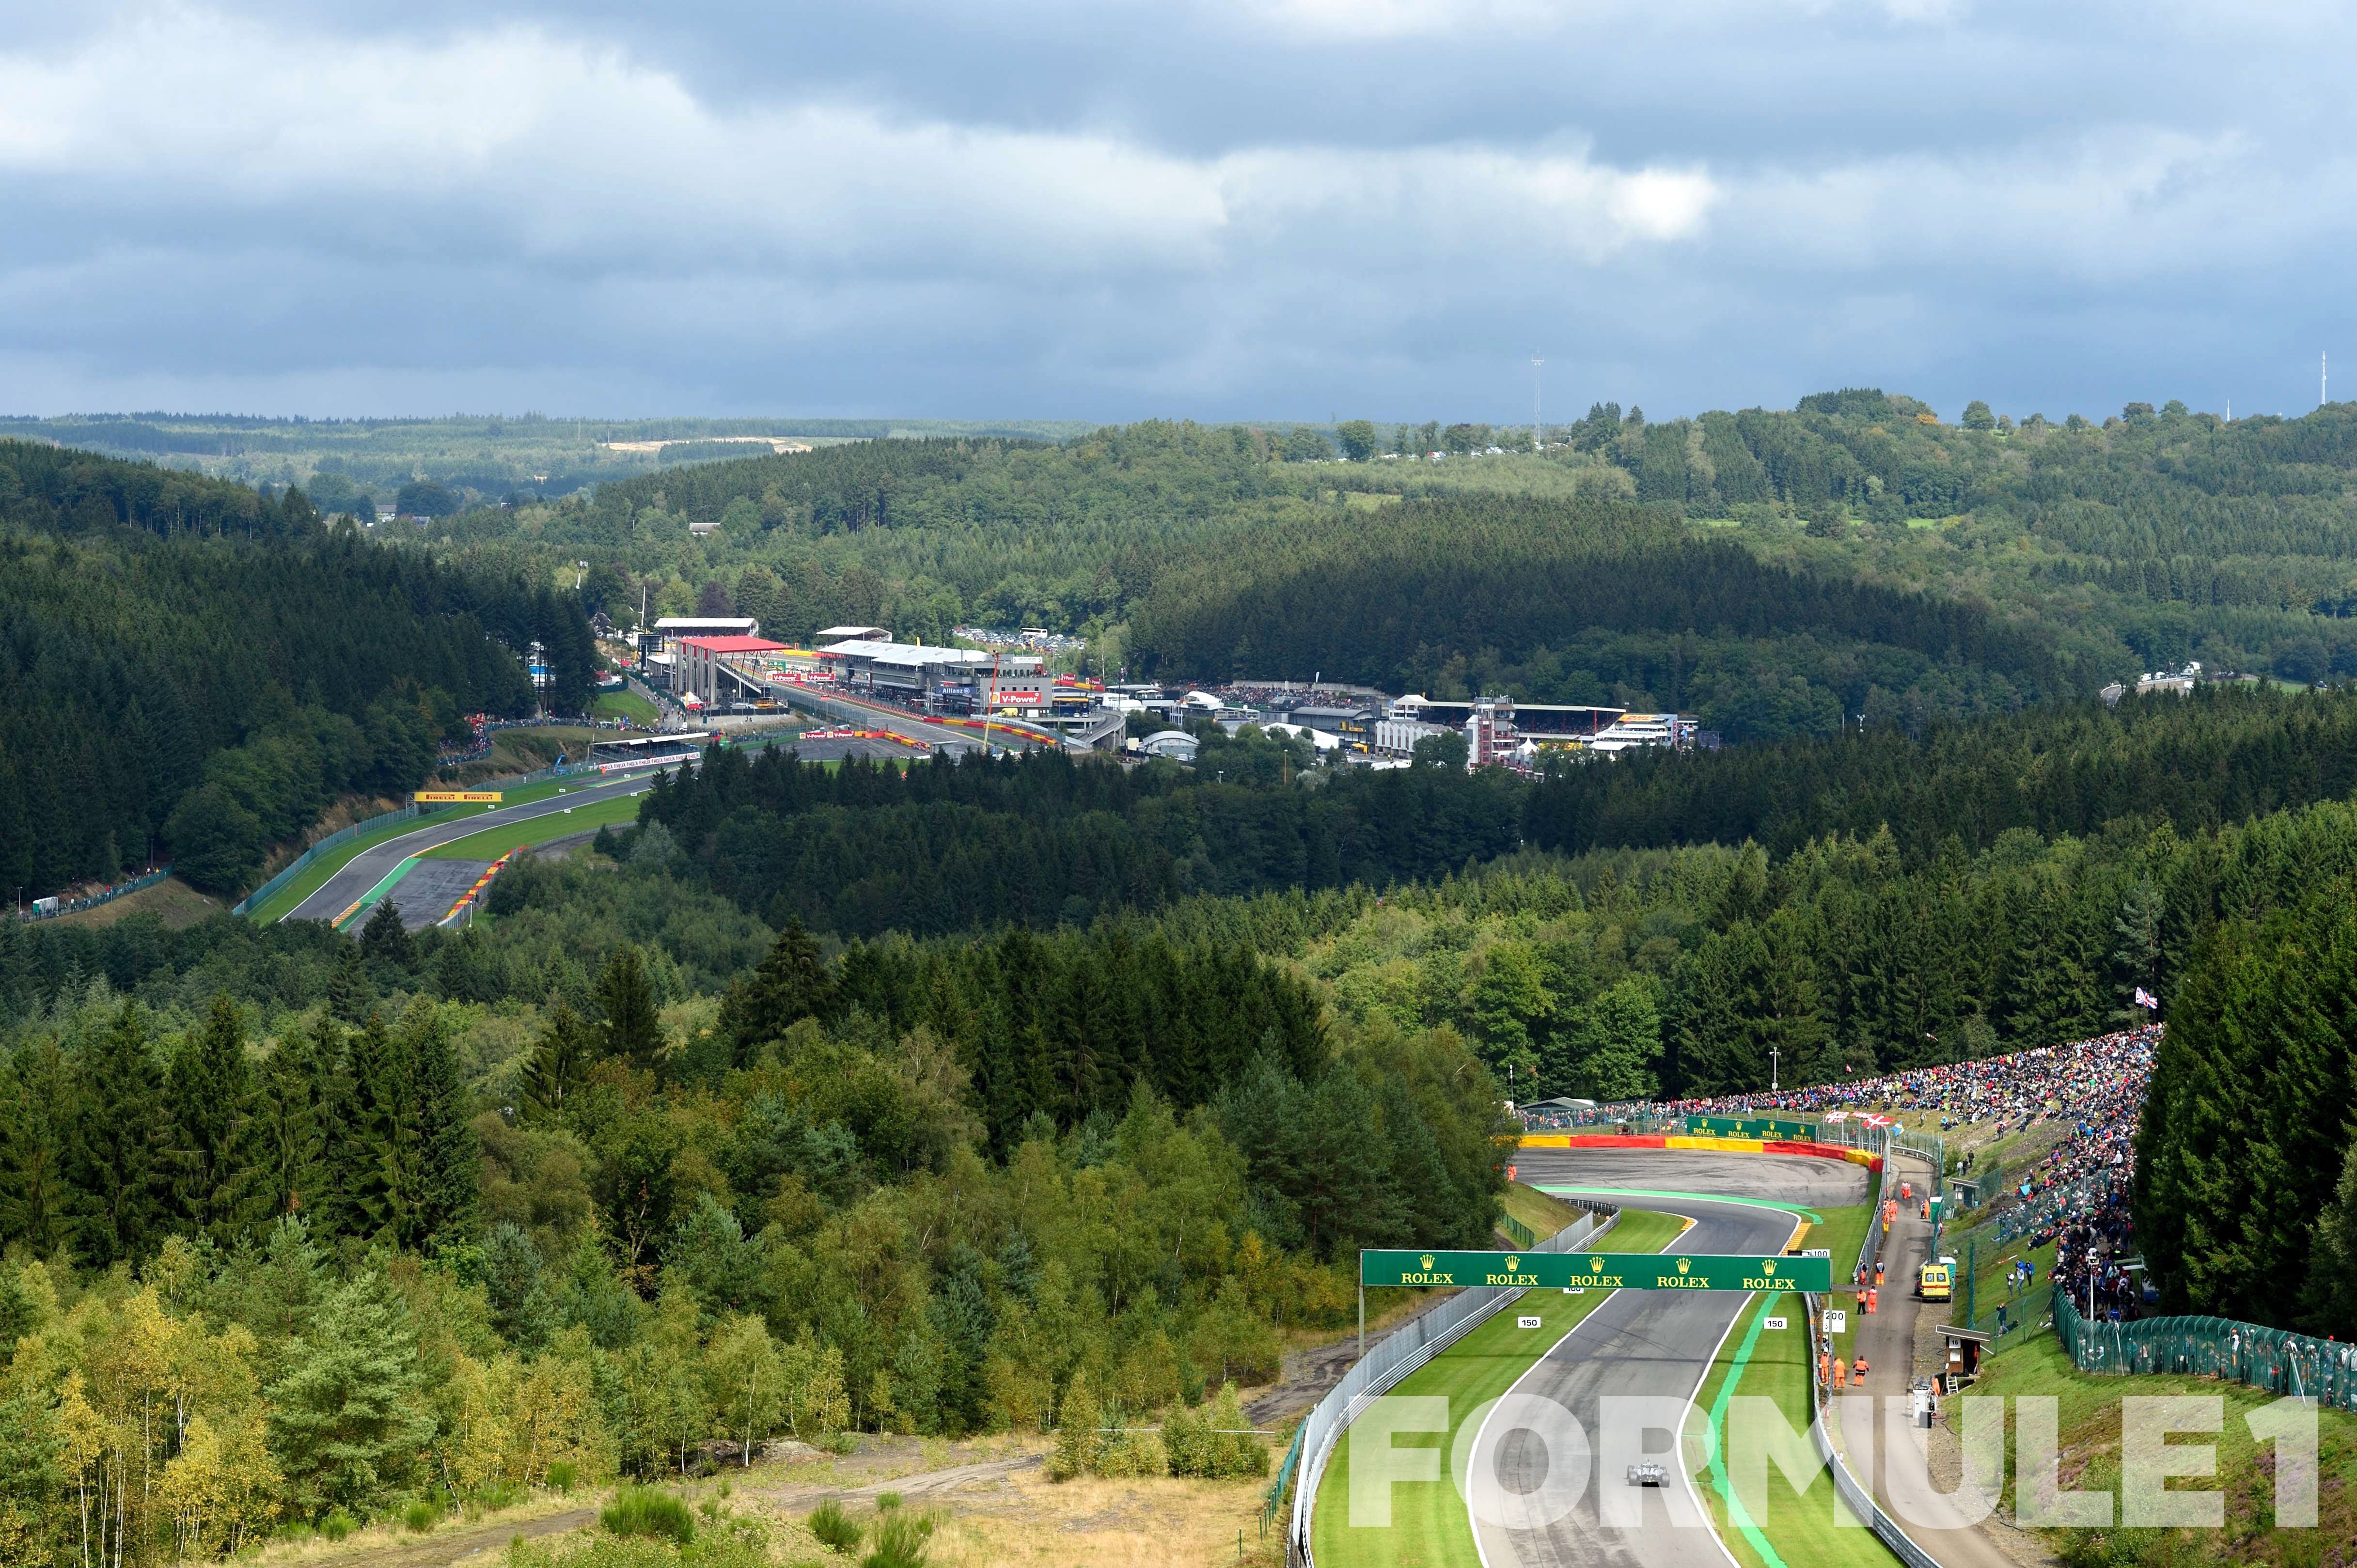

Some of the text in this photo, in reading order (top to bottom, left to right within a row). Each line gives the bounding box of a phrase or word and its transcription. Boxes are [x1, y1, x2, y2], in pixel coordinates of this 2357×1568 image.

[1401, 1273, 1795, 1290] ROLEX ROLEX ROLEX ROLEX ROLEX
